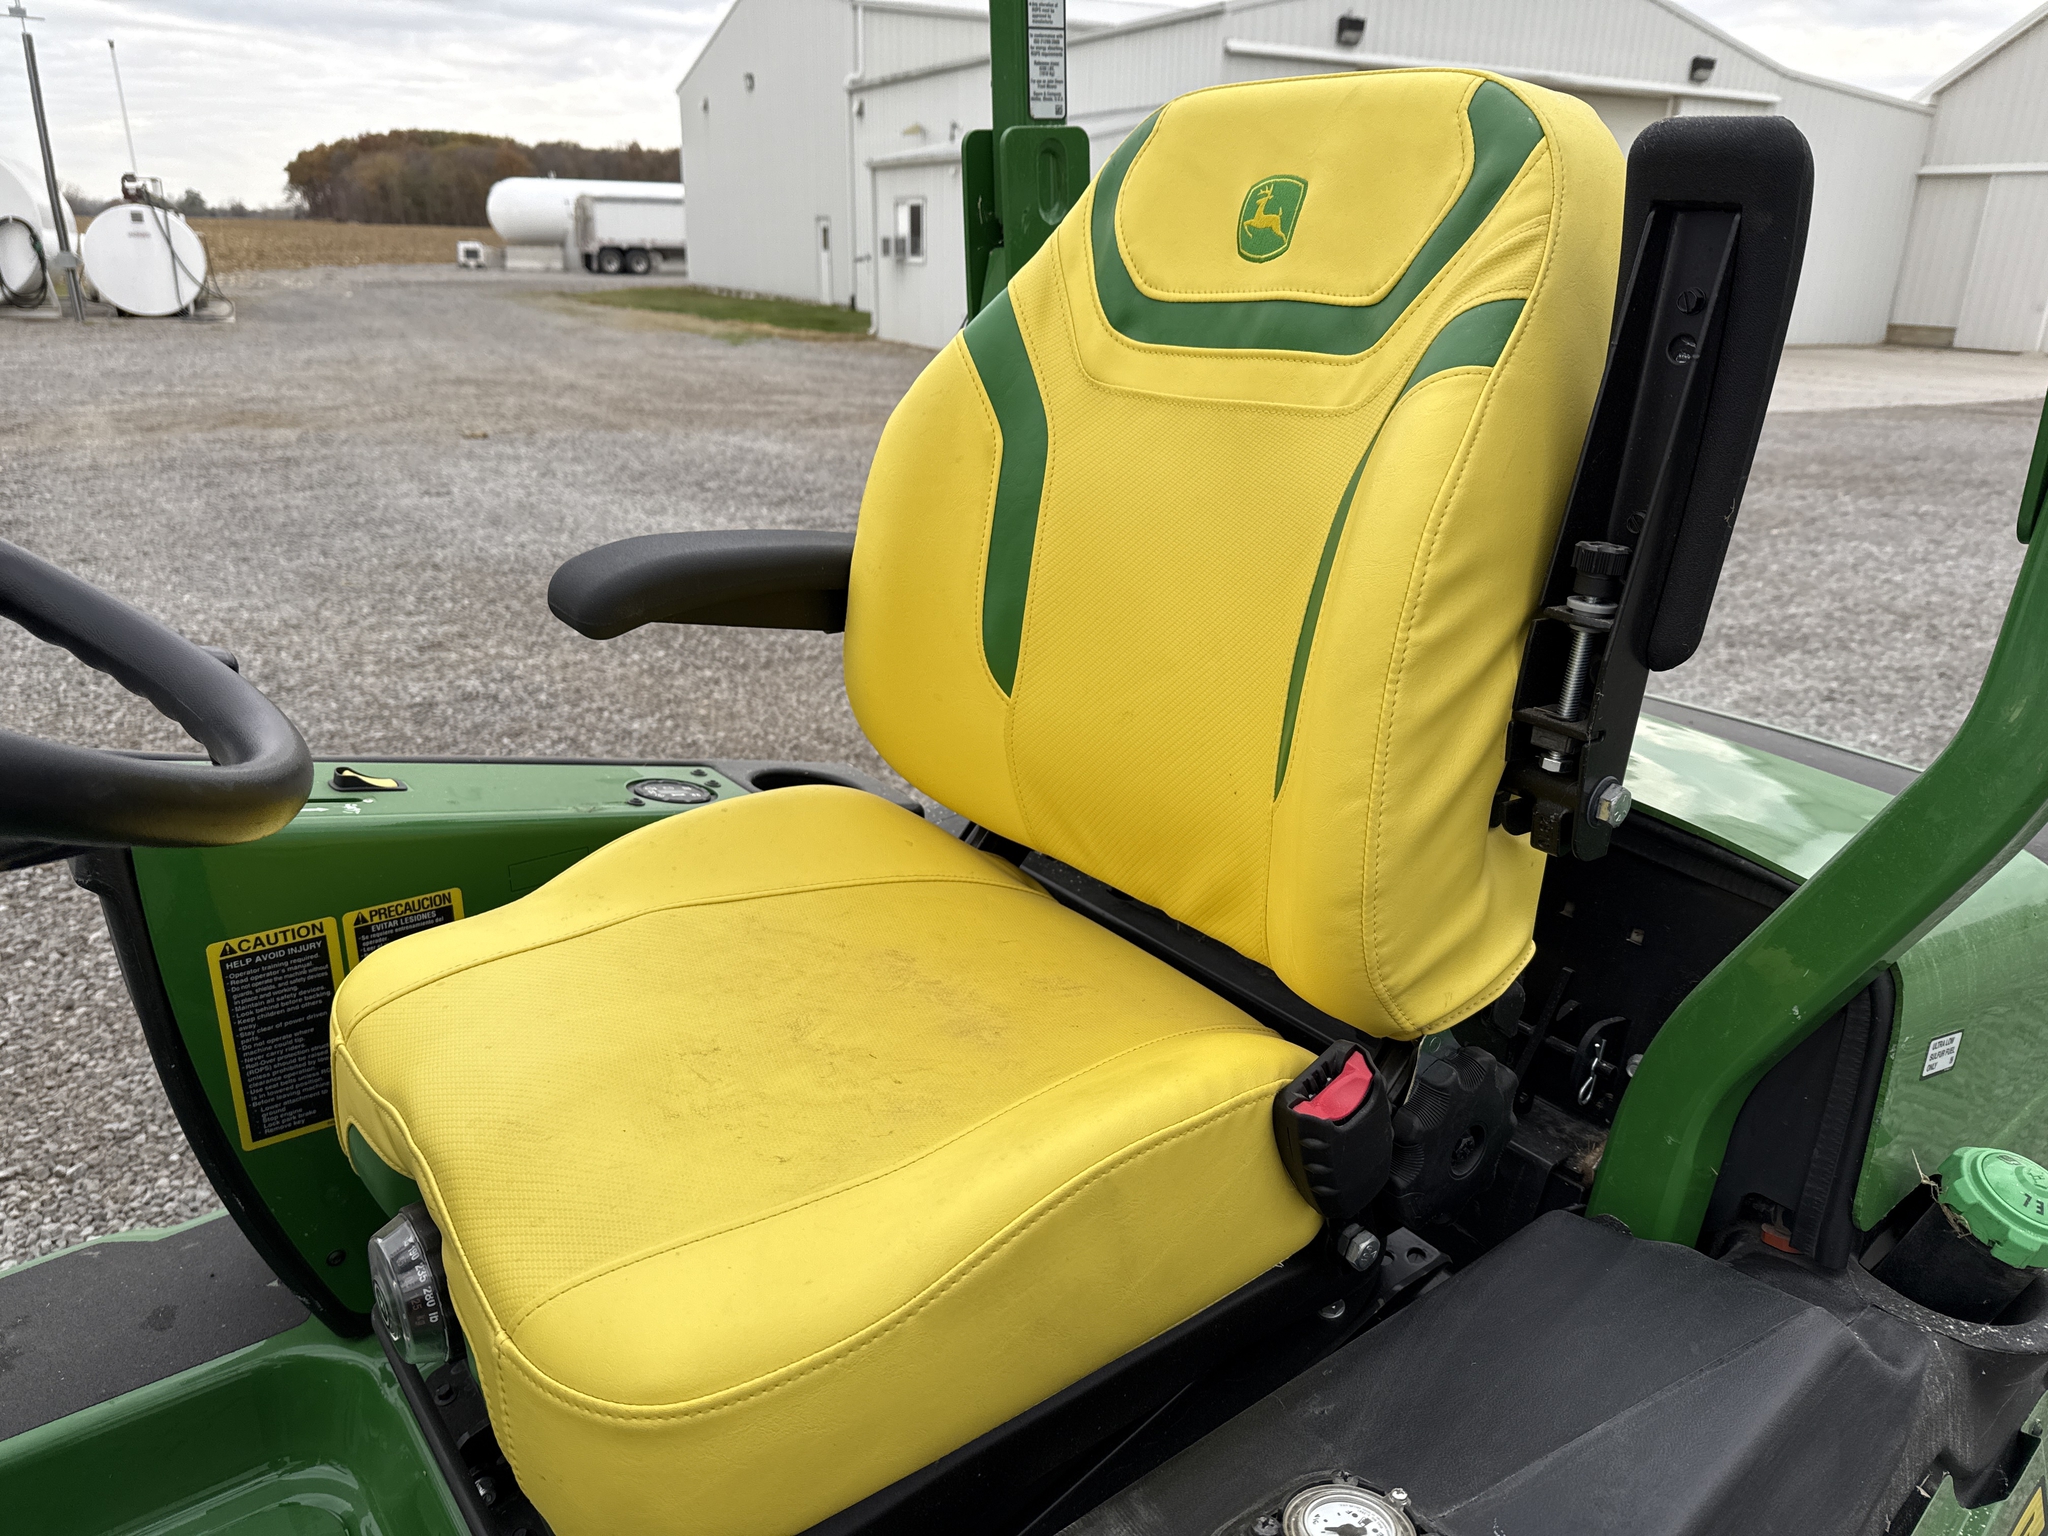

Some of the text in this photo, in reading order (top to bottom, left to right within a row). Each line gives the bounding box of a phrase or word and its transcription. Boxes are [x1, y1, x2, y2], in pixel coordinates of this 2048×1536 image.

[369, 892, 452, 922] PRECAUCION
[370, 929, 393, 939] requiere
[395, 919, 434, 933] entrenamiento
[372, 911, 436, 932] EVITAR LESIONES
[238, 922, 324, 952] CAUTION
[226, 941, 322, 970] HELP AVOID INJURY
[229, 953, 320, 979] Operator training required.
[287, 961, 313, 973] manual.
[252, 978, 273, 988] operate
[284, 968, 307, 980] machine
[308, 964, 328, 973] without
[290, 977, 306, 986] safety
[307, 972, 328, 980] devices
[235, 1001, 264, 1011] Maintain
[276, 992, 297, 1001] safety
[298, 986, 326, 995] devices.
[241, 996, 258, 1004] place
[272, 985, 298, 995] working.
[238, 1016, 255, 1024] Keep
[257, 1009, 285, 1020] children
[301, 1000, 322, 1008] others
[256, 1004, 279, 1013] behind
[281, 998, 302, 1007] before
[284, 1017, 305, 1027] power
[306, 1011, 327, 1020] driven
[267, 1034, 292, 1044] operate
[294, 1028, 314, 1036] where
[1932, 1037, 1955, 1050] ULTRA LOW
[243, 1046, 272, 1057] machine
[245, 1055, 264, 1063] Never
[266, 1049, 283, 1057] carry
[274, 1058, 296, 1068] should
[308, 1049, 329, 1059] raised
[277, 1048, 310, 1061] protection
[311, 1043, 329, 1051] struct
[1929, 1047, 1955, 1061] SULFUR FUEL
[248, 1073, 270, 1082] unless
[272, 1062, 306, 1076] prohibited
[1926, 1062, 1938, 1072] ONLY
[249, 1076, 282, 1088] clearance
[265, 1083, 278, 1091] seat
[281, 1078, 296, 1086] belts
[298, 1072, 319, 1082] unless
[267, 1085, 294, 1096] lowered
[252, 1097, 275, 1107] Before
[276, 1089, 301, 1100] leaving
[261, 1103, 281, 1112] Lower
[283, 1091, 320, 1106] attachment
[262, 1107, 286, 1118] ground
[280, 1108, 302, 1118] engine
[282, 1116, 296, 1124] park
[298, 1110, 316, 1118] brake
[264, 1123, 292, 1134] Remove
[415, 1262, 427, 1282] 235
[423, 1286, 436, 1307] 280
[429, 1312, 439, 1322] lb
